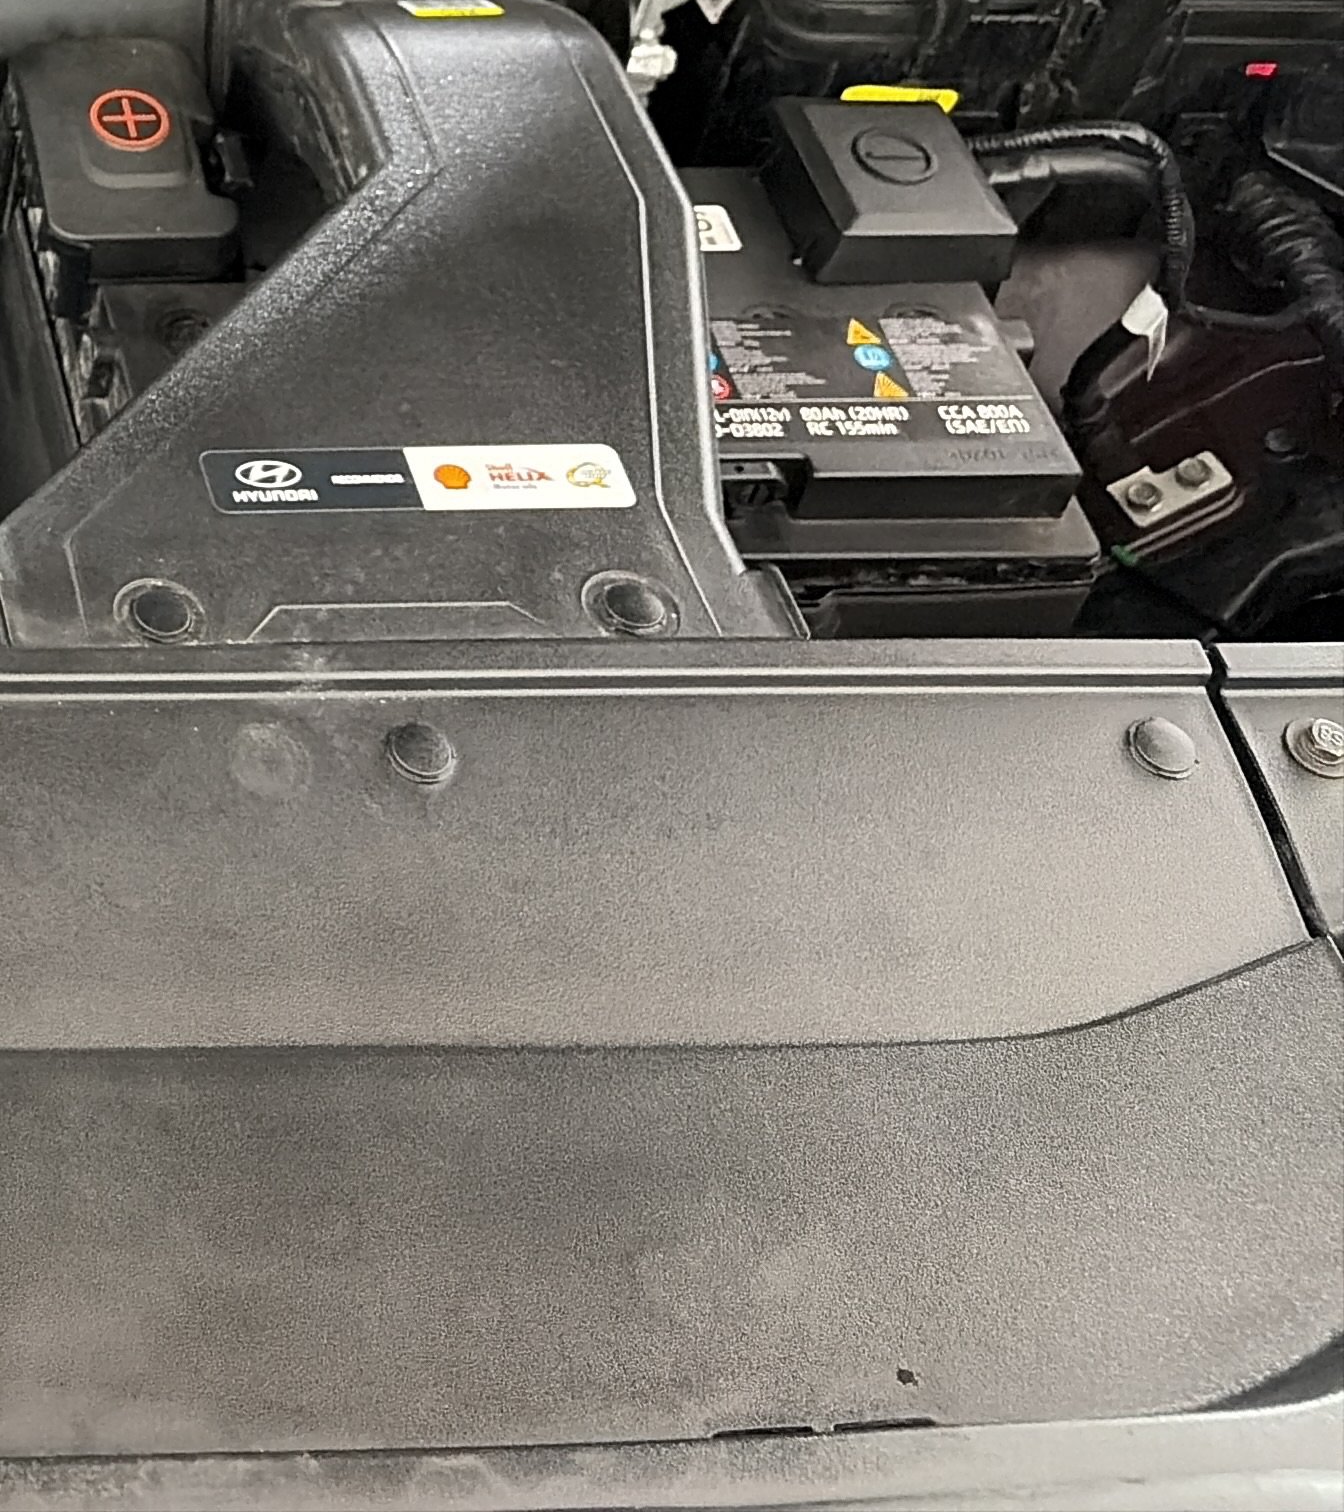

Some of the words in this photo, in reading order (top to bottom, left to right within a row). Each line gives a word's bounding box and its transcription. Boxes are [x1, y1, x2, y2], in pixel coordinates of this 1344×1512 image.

[937, 405, 977, 420] CCA
[806, 421, 834, 436] RC
[835, 420, 899, 435] 155min
[489, 471, 555, 482] HELIX
[232, 489, 319, 503] HYUNDAI
